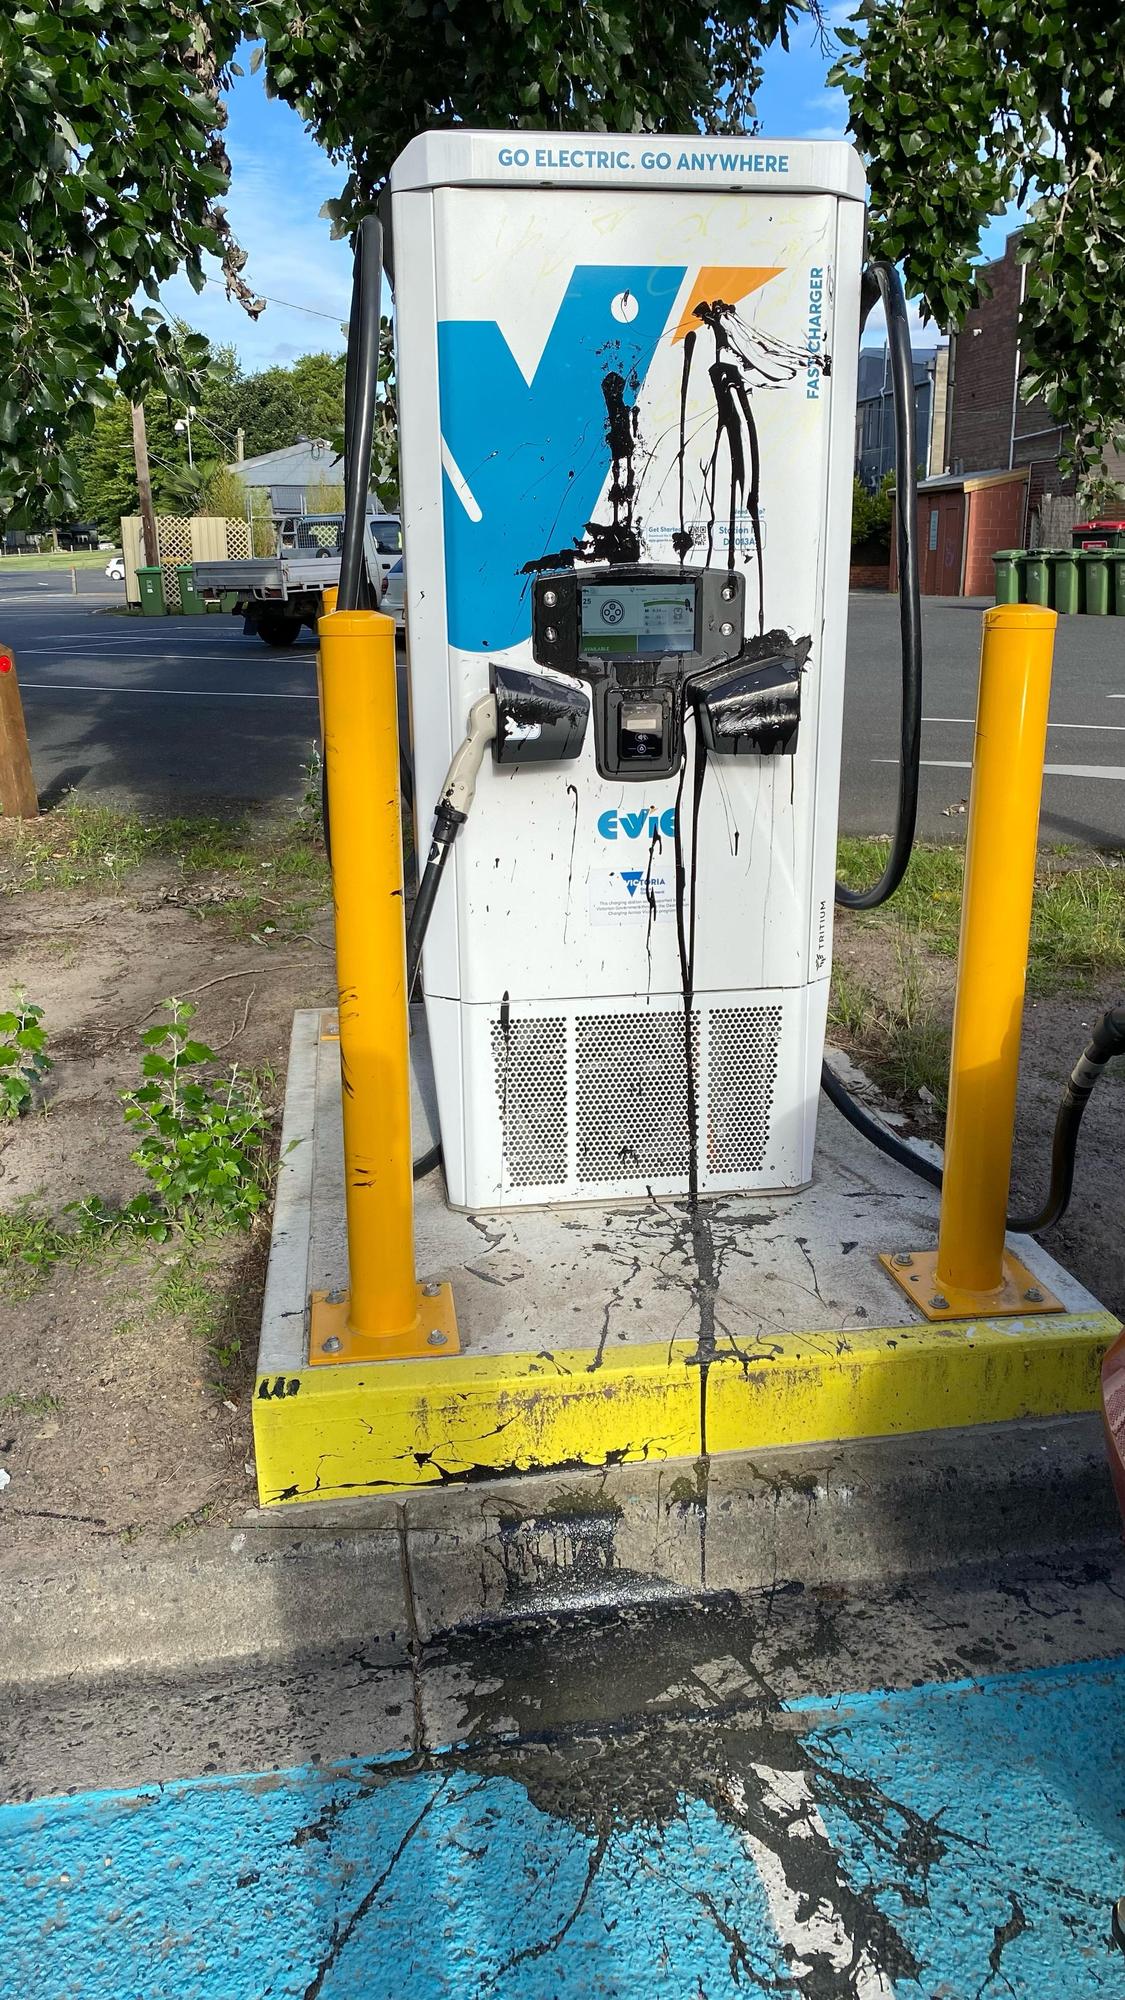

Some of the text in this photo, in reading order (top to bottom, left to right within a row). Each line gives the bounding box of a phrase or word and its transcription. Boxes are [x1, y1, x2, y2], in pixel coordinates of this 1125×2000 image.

[498, 149, 789, 172] GO ELECTRIC. GO ANYWHERE
[806, 267, 823, 399] FAST CHARGER
[624, 878, 666, 887] VICTORIA
